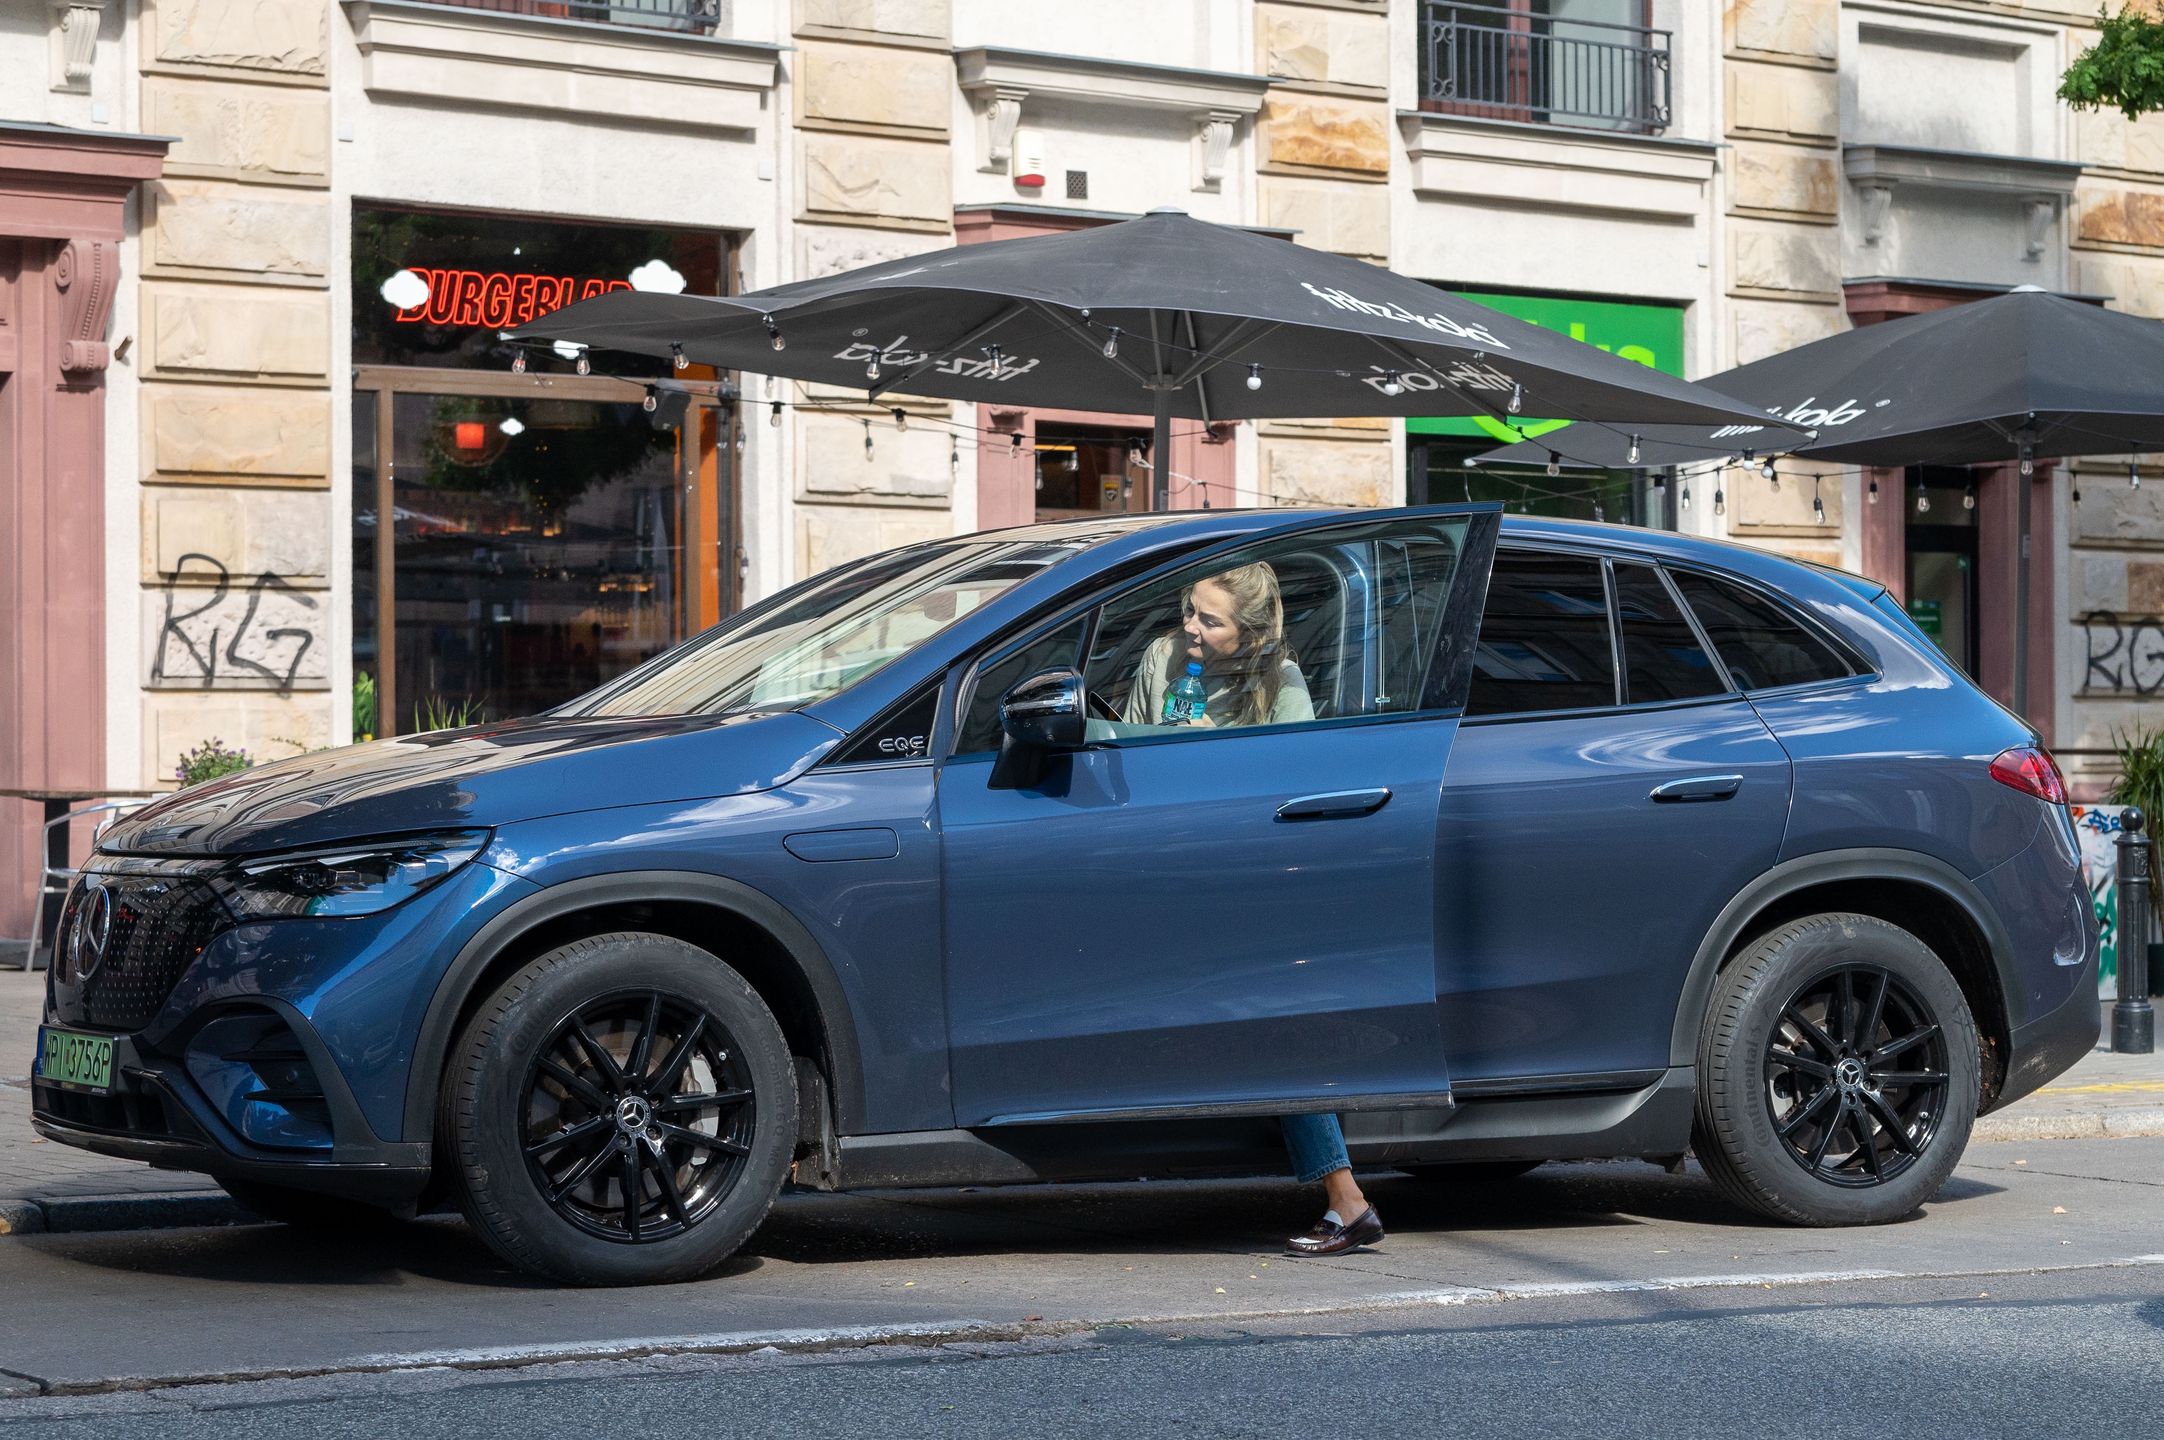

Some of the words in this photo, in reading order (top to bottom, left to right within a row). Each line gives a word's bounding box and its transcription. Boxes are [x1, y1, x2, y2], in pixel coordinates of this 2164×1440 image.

[396, 267, 632, 328] URGER
[879, 735, 925, 753] EQE
[68, 1038, 112, 1083] 3756P
